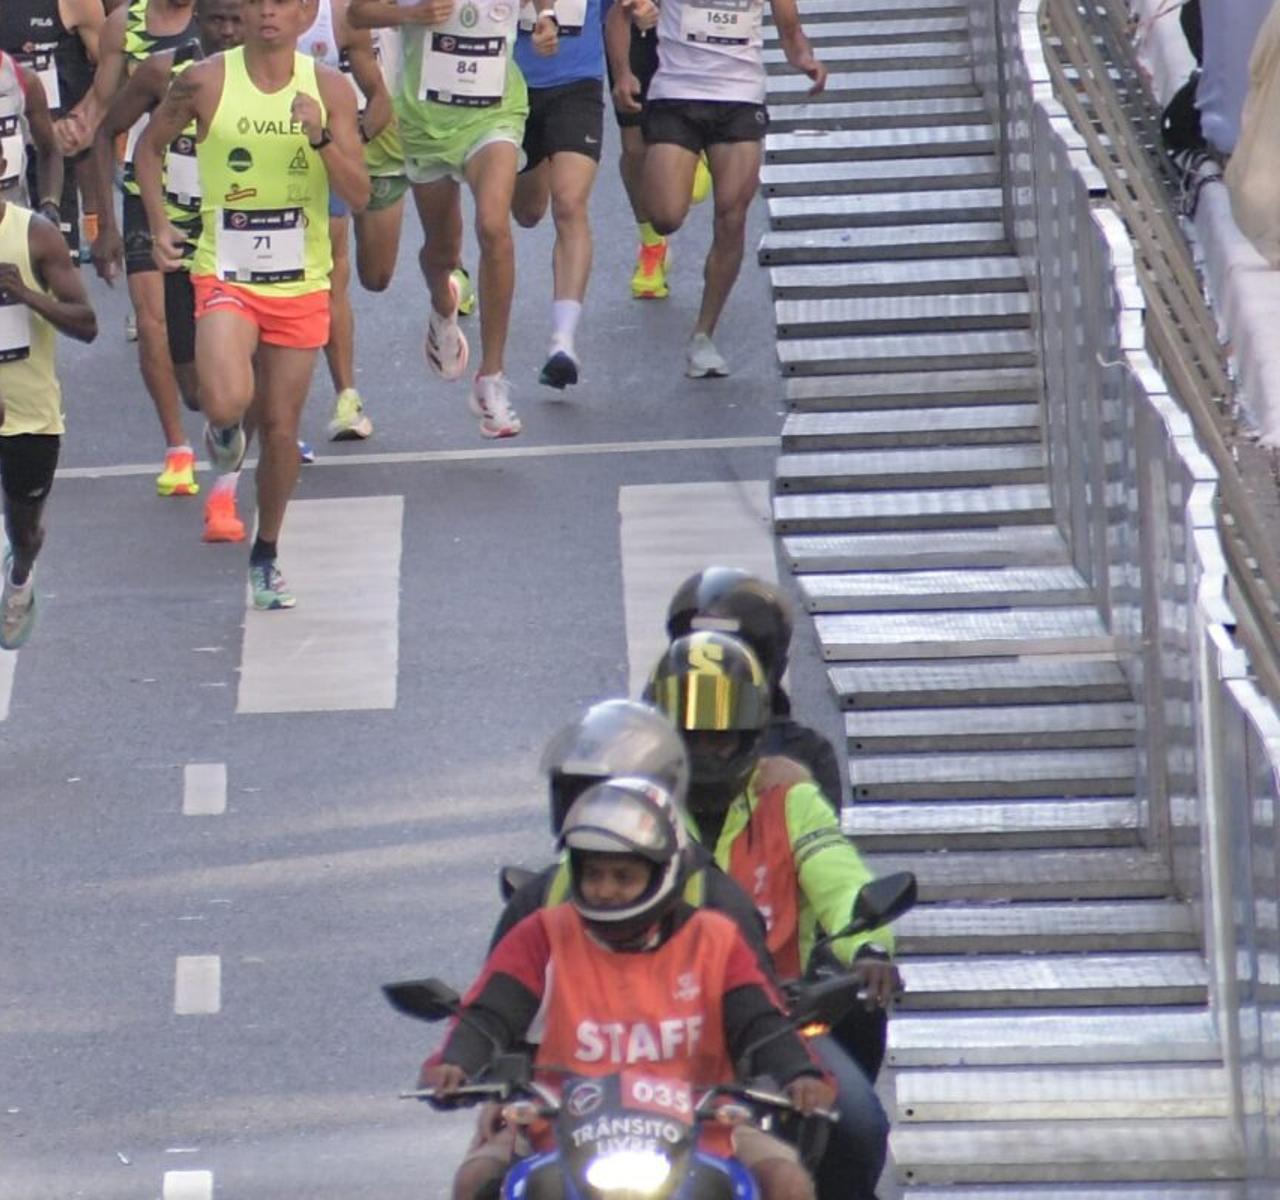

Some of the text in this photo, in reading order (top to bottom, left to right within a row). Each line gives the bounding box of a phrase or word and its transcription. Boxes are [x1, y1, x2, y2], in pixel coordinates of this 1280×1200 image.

[707, 11, 739, 26] 1658
[456, 60, 478, 75] 84
[253, 235, 272, 250] 71
[573, 1014, 704, 1064] STAFF
[632, 1081, 690, 1114] 035
[571, 1115, 683, 1146] TRÂNSITO
